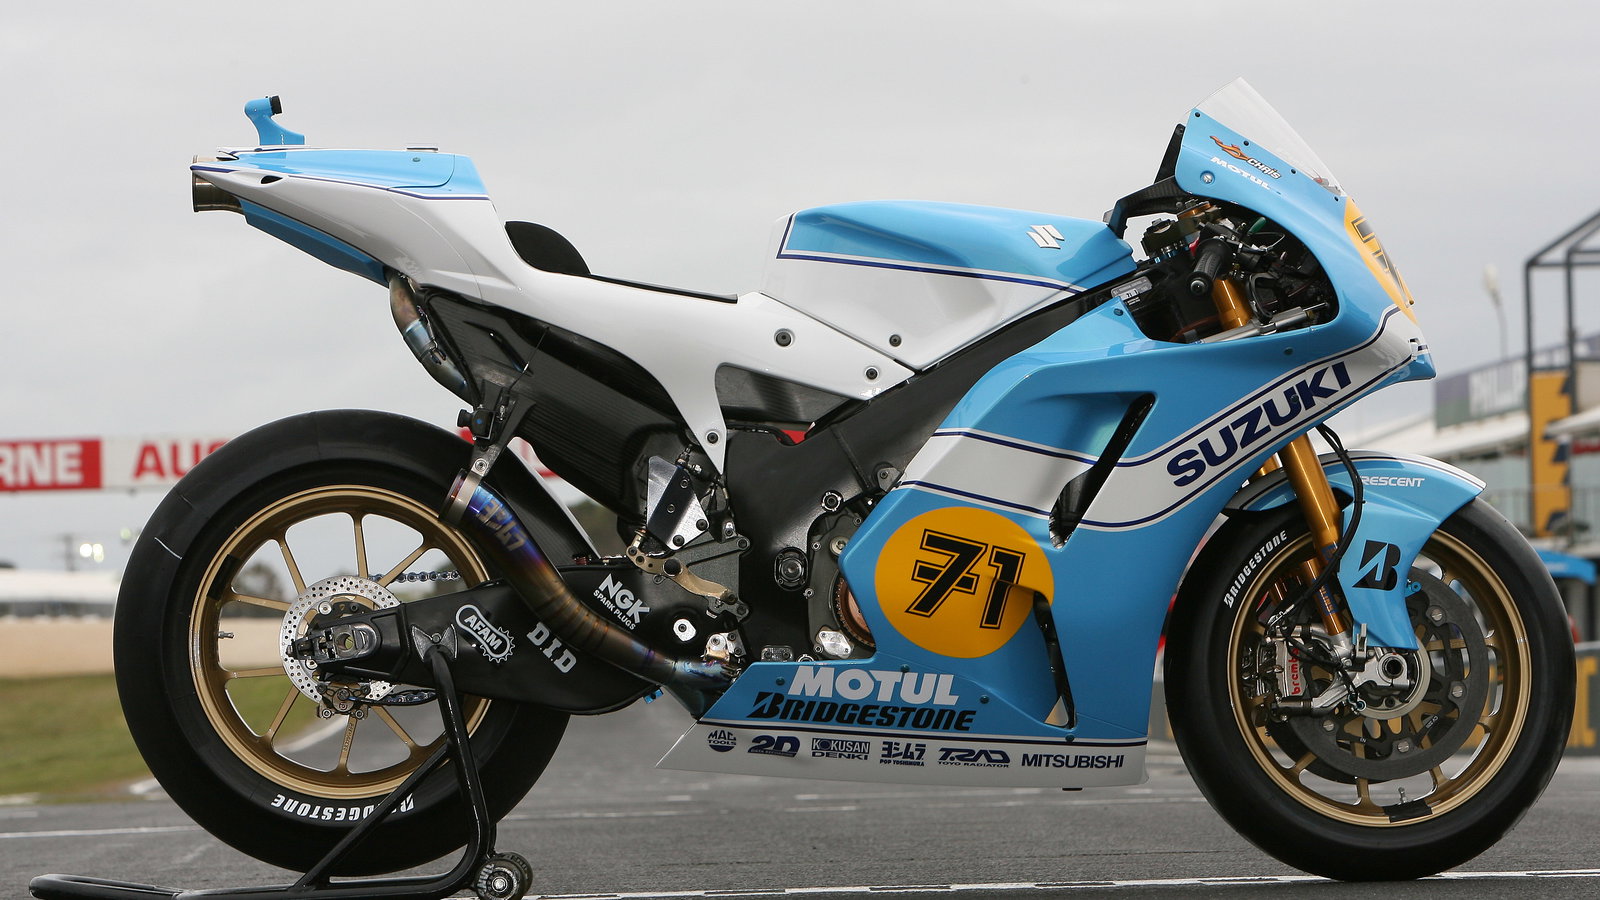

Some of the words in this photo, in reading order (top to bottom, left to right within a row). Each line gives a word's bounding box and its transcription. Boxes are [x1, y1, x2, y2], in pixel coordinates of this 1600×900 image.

[1210, 156, 1272, 190] MOTUL
[1166, 361, 1352, 487] SUZUKI
[1356, 475, 1425, 488] RESCENT
[904, 528, 1026, 630] 71
[1223, 530, 1287, 608] BRIDGESTONE
[593, 589, 615, 614] SPARK
[613, 608, 636, 631] PLUGS
[599, 573, 650, 624] NGK
[464, 614, 503, 650] AFAM
[526, 621, 577, 673] D.I.D
[787, 665, 960, 706] MOTUL
[746, 691, 977, 731] BRIDGESTONE
[708, 730, 737, 741] MAC
[748, 735, 800, 755] 2D
[812, 738, 870, 753] KOKUSAN
[811, 751, 869, 761] DENKI
[1021, 753, 1125, 769] MITSUBISHI
